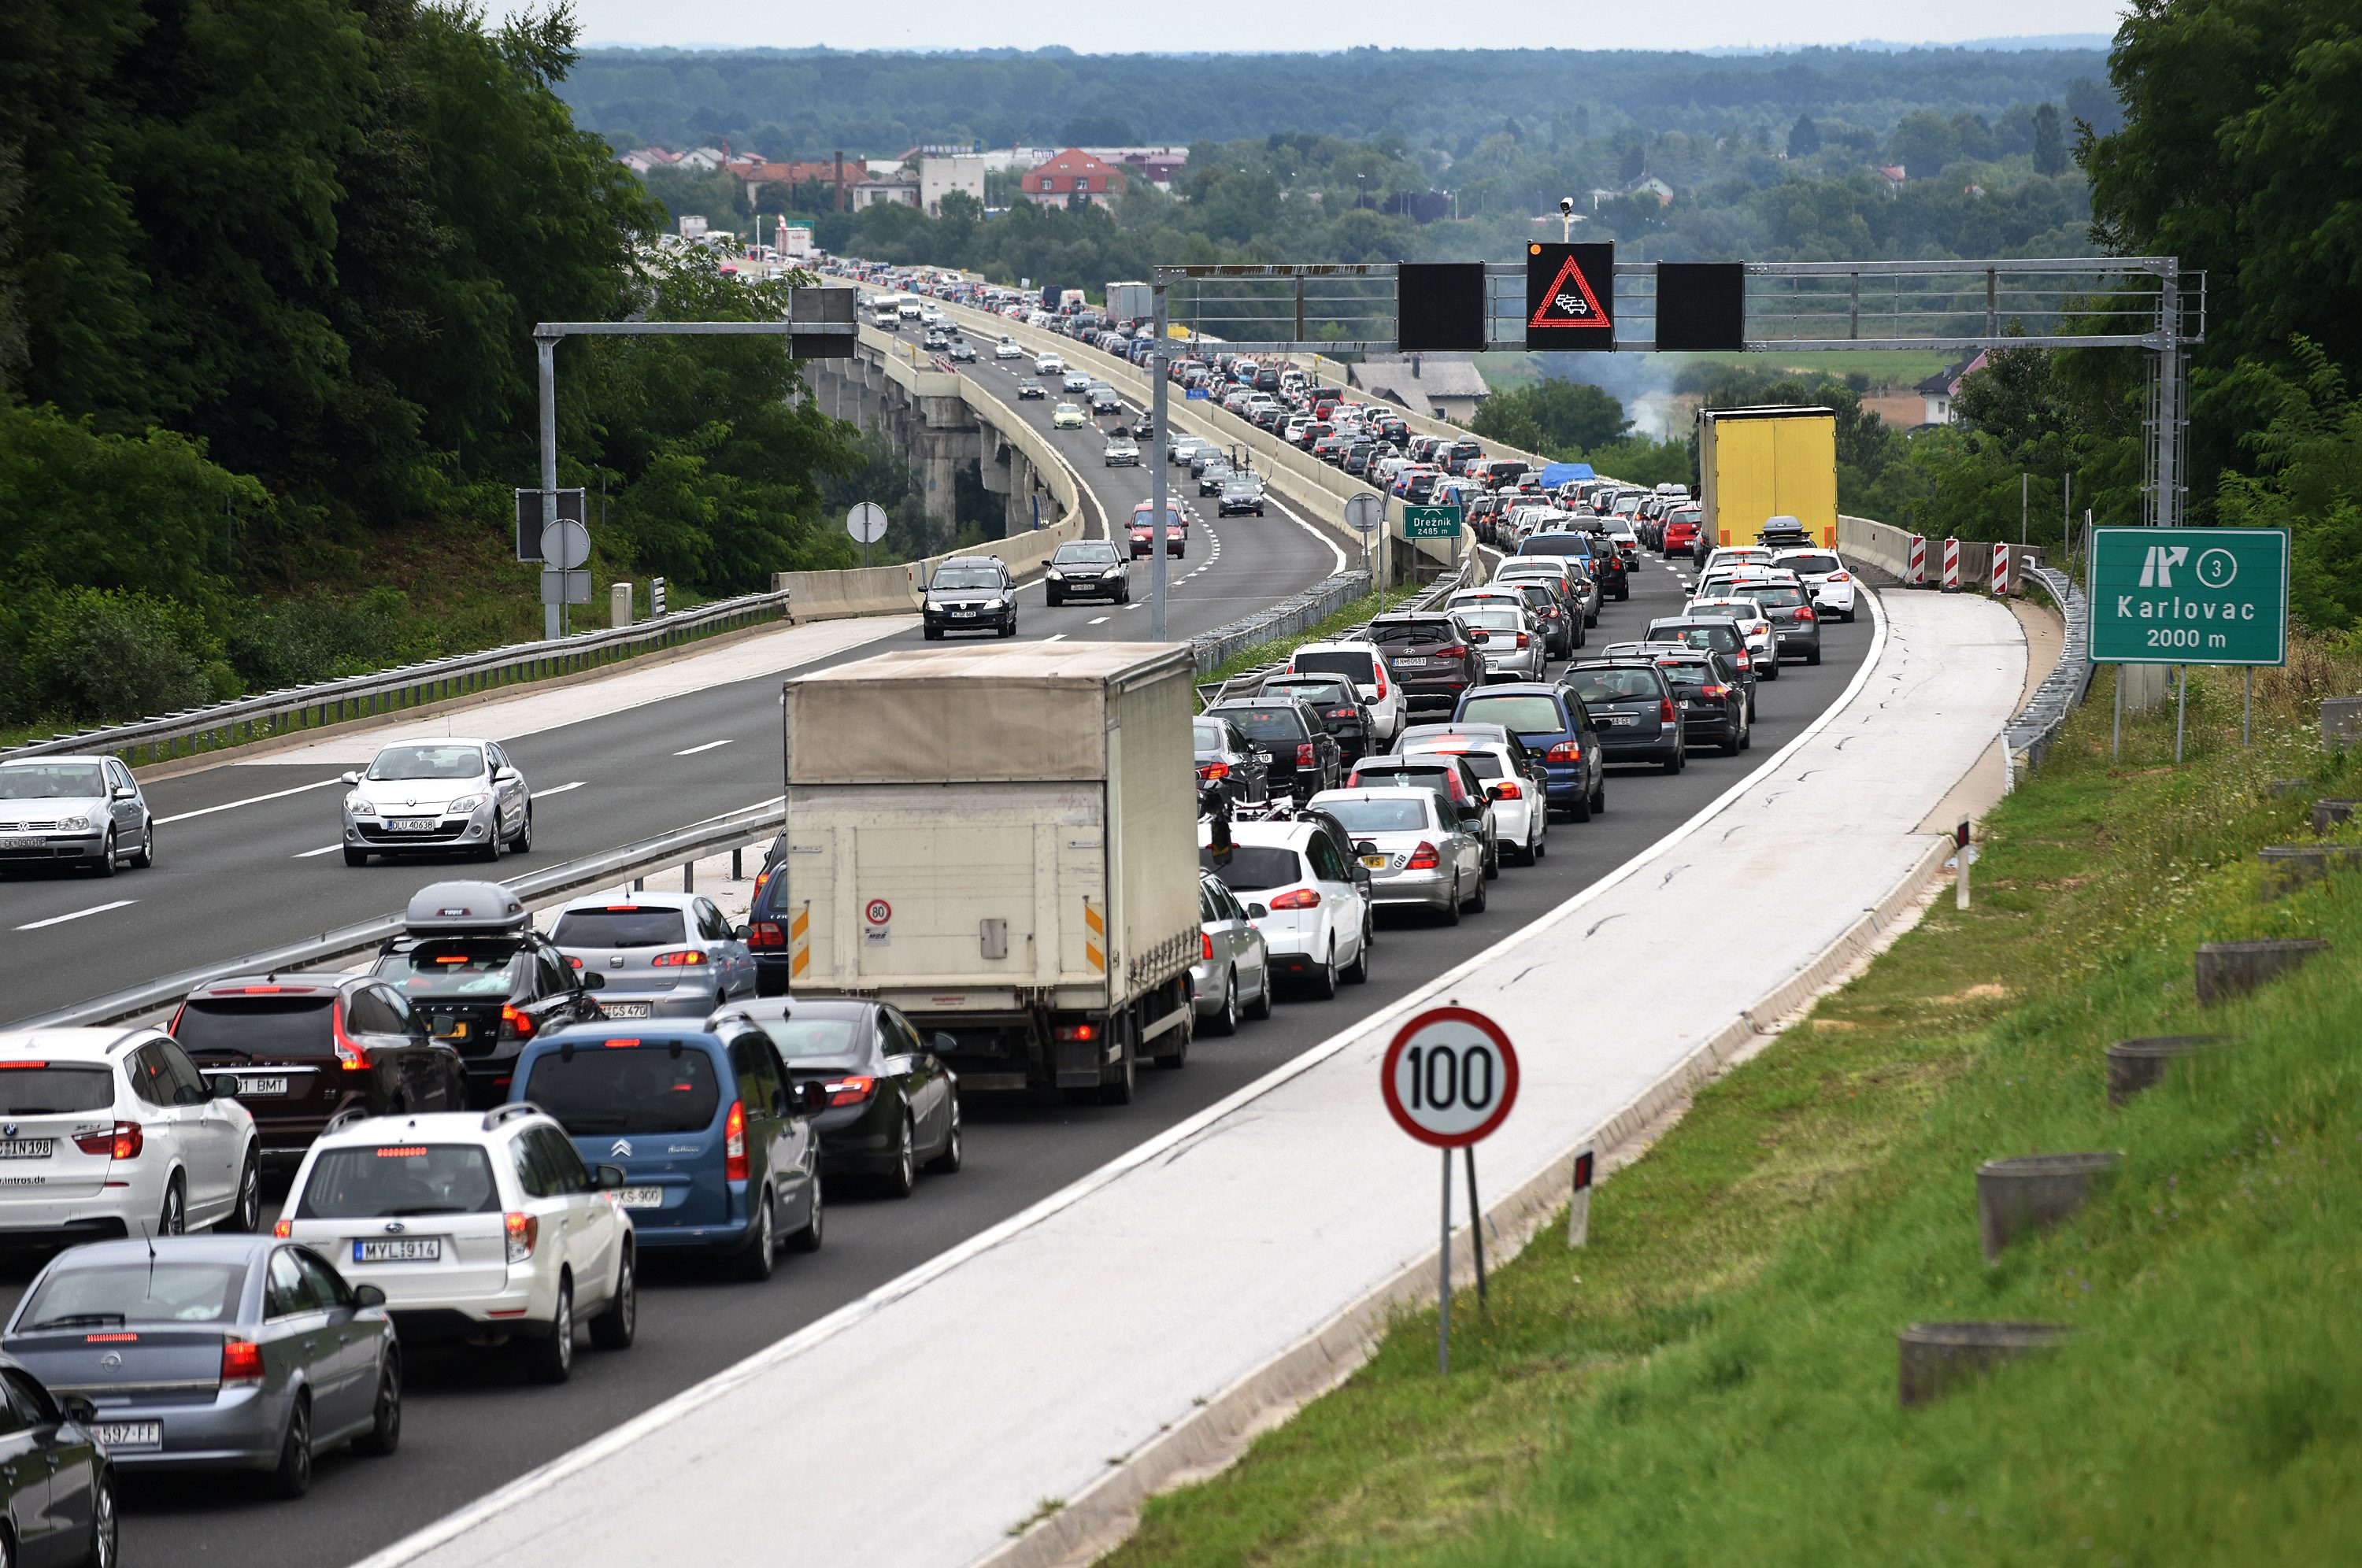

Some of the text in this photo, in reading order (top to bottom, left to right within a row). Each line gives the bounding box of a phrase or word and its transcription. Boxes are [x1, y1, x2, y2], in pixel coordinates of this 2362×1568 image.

[1414, 517, 1451, 527] Drežnik
[2212, 560, 2222, 578] 3
[2117, 595, 2255, 620] Karlovac
[2146, 629, 2227, 648] 2000 m
[1394, 854, 1407, 868] GB
[872, 906, 884, 919] 80
[613, 1006, 646, 1016] CS 470
[257, 1080, 283, 1092] BMT
[1407, 1045, 1493, 1112] 100
[12, 1139, 49, 1155] IN 198
[365, 1241, 435, 1259] MYL 914
